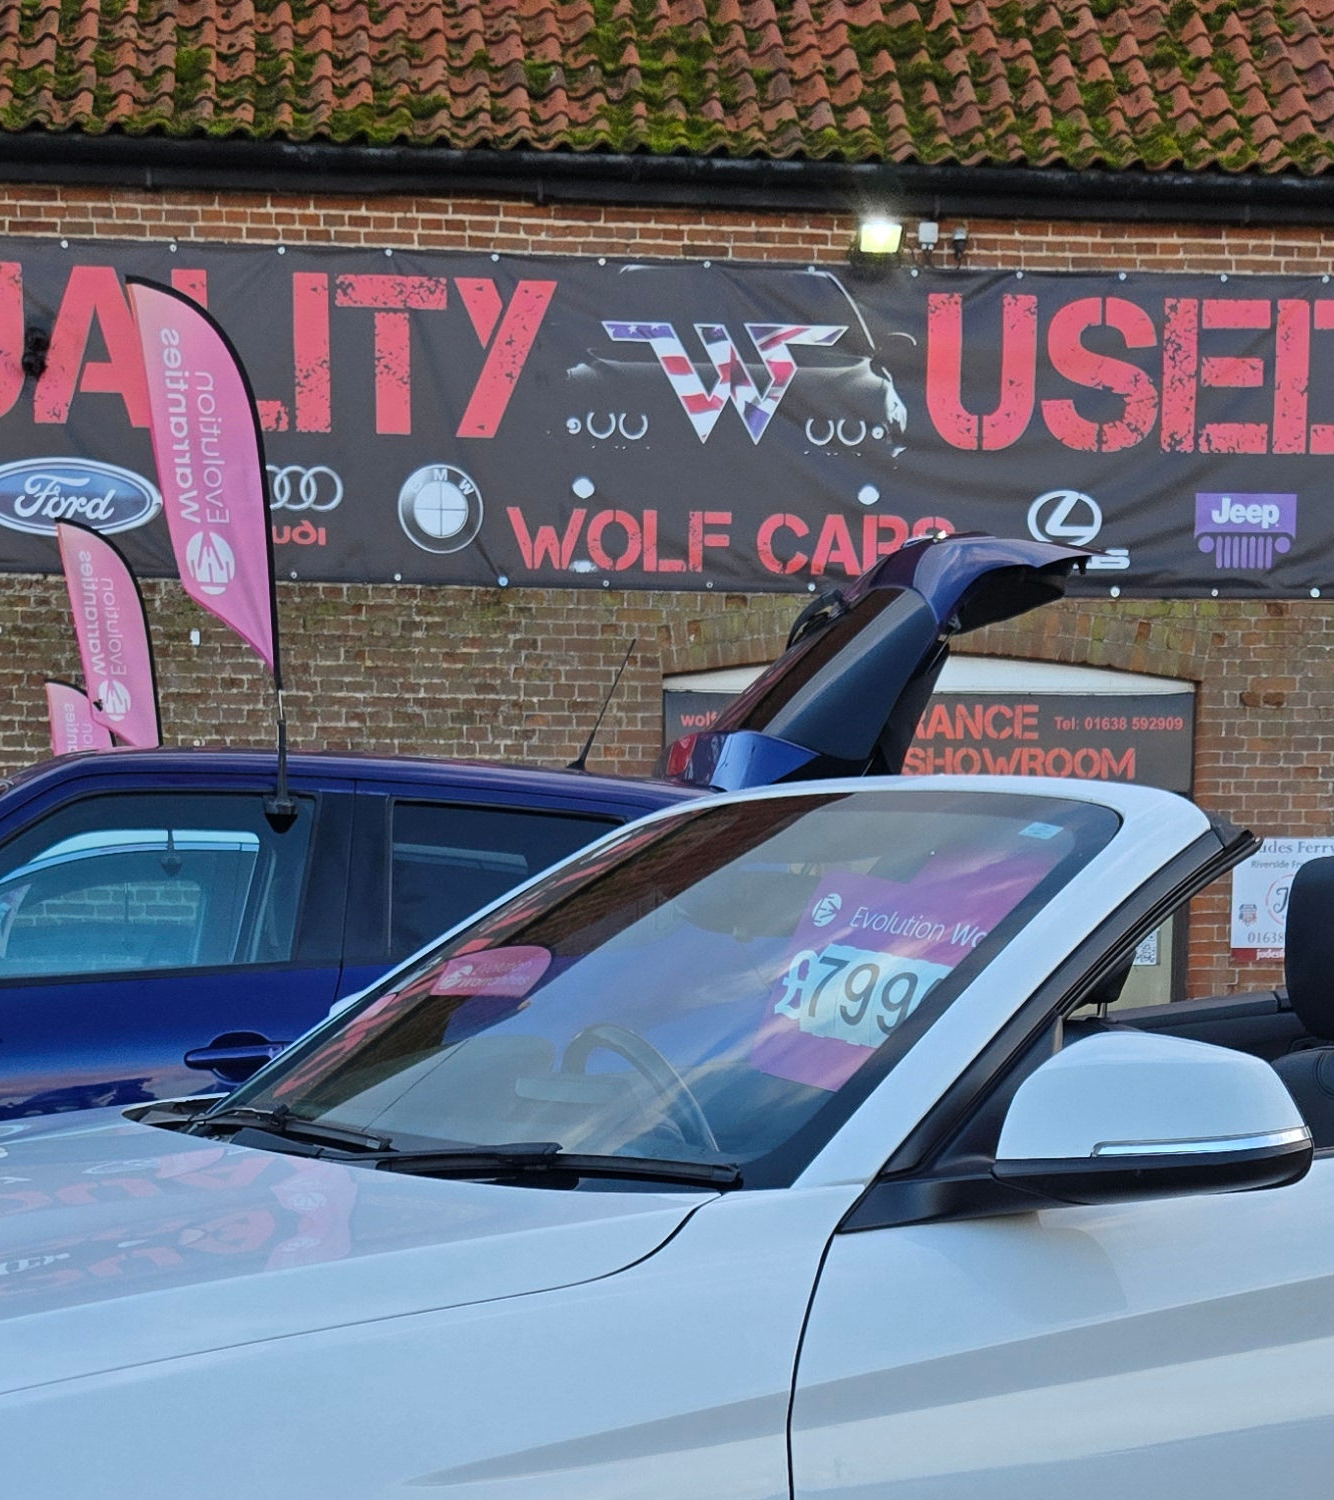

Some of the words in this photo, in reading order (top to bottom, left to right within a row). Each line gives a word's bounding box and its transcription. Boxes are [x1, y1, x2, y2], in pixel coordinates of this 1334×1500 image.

[13, 473, 117, 521] Ford
[1211, 497, 1281, 529] Jeep
[272, 519, 327, 546] udi
[506, 506, 732, 573] WOLF
[916, 704, 1039, 740] ANCE
[1054, 717, 1079, 731] Tel:
[1084, 716, 1127, 731] 01638
[1130, 717, 1184, 731] 592909
[901, 747, 1136, 780] SHOWROOM
[1258, 841, 1292, 854] udes
[849, 906, 945, 941] Evolution
